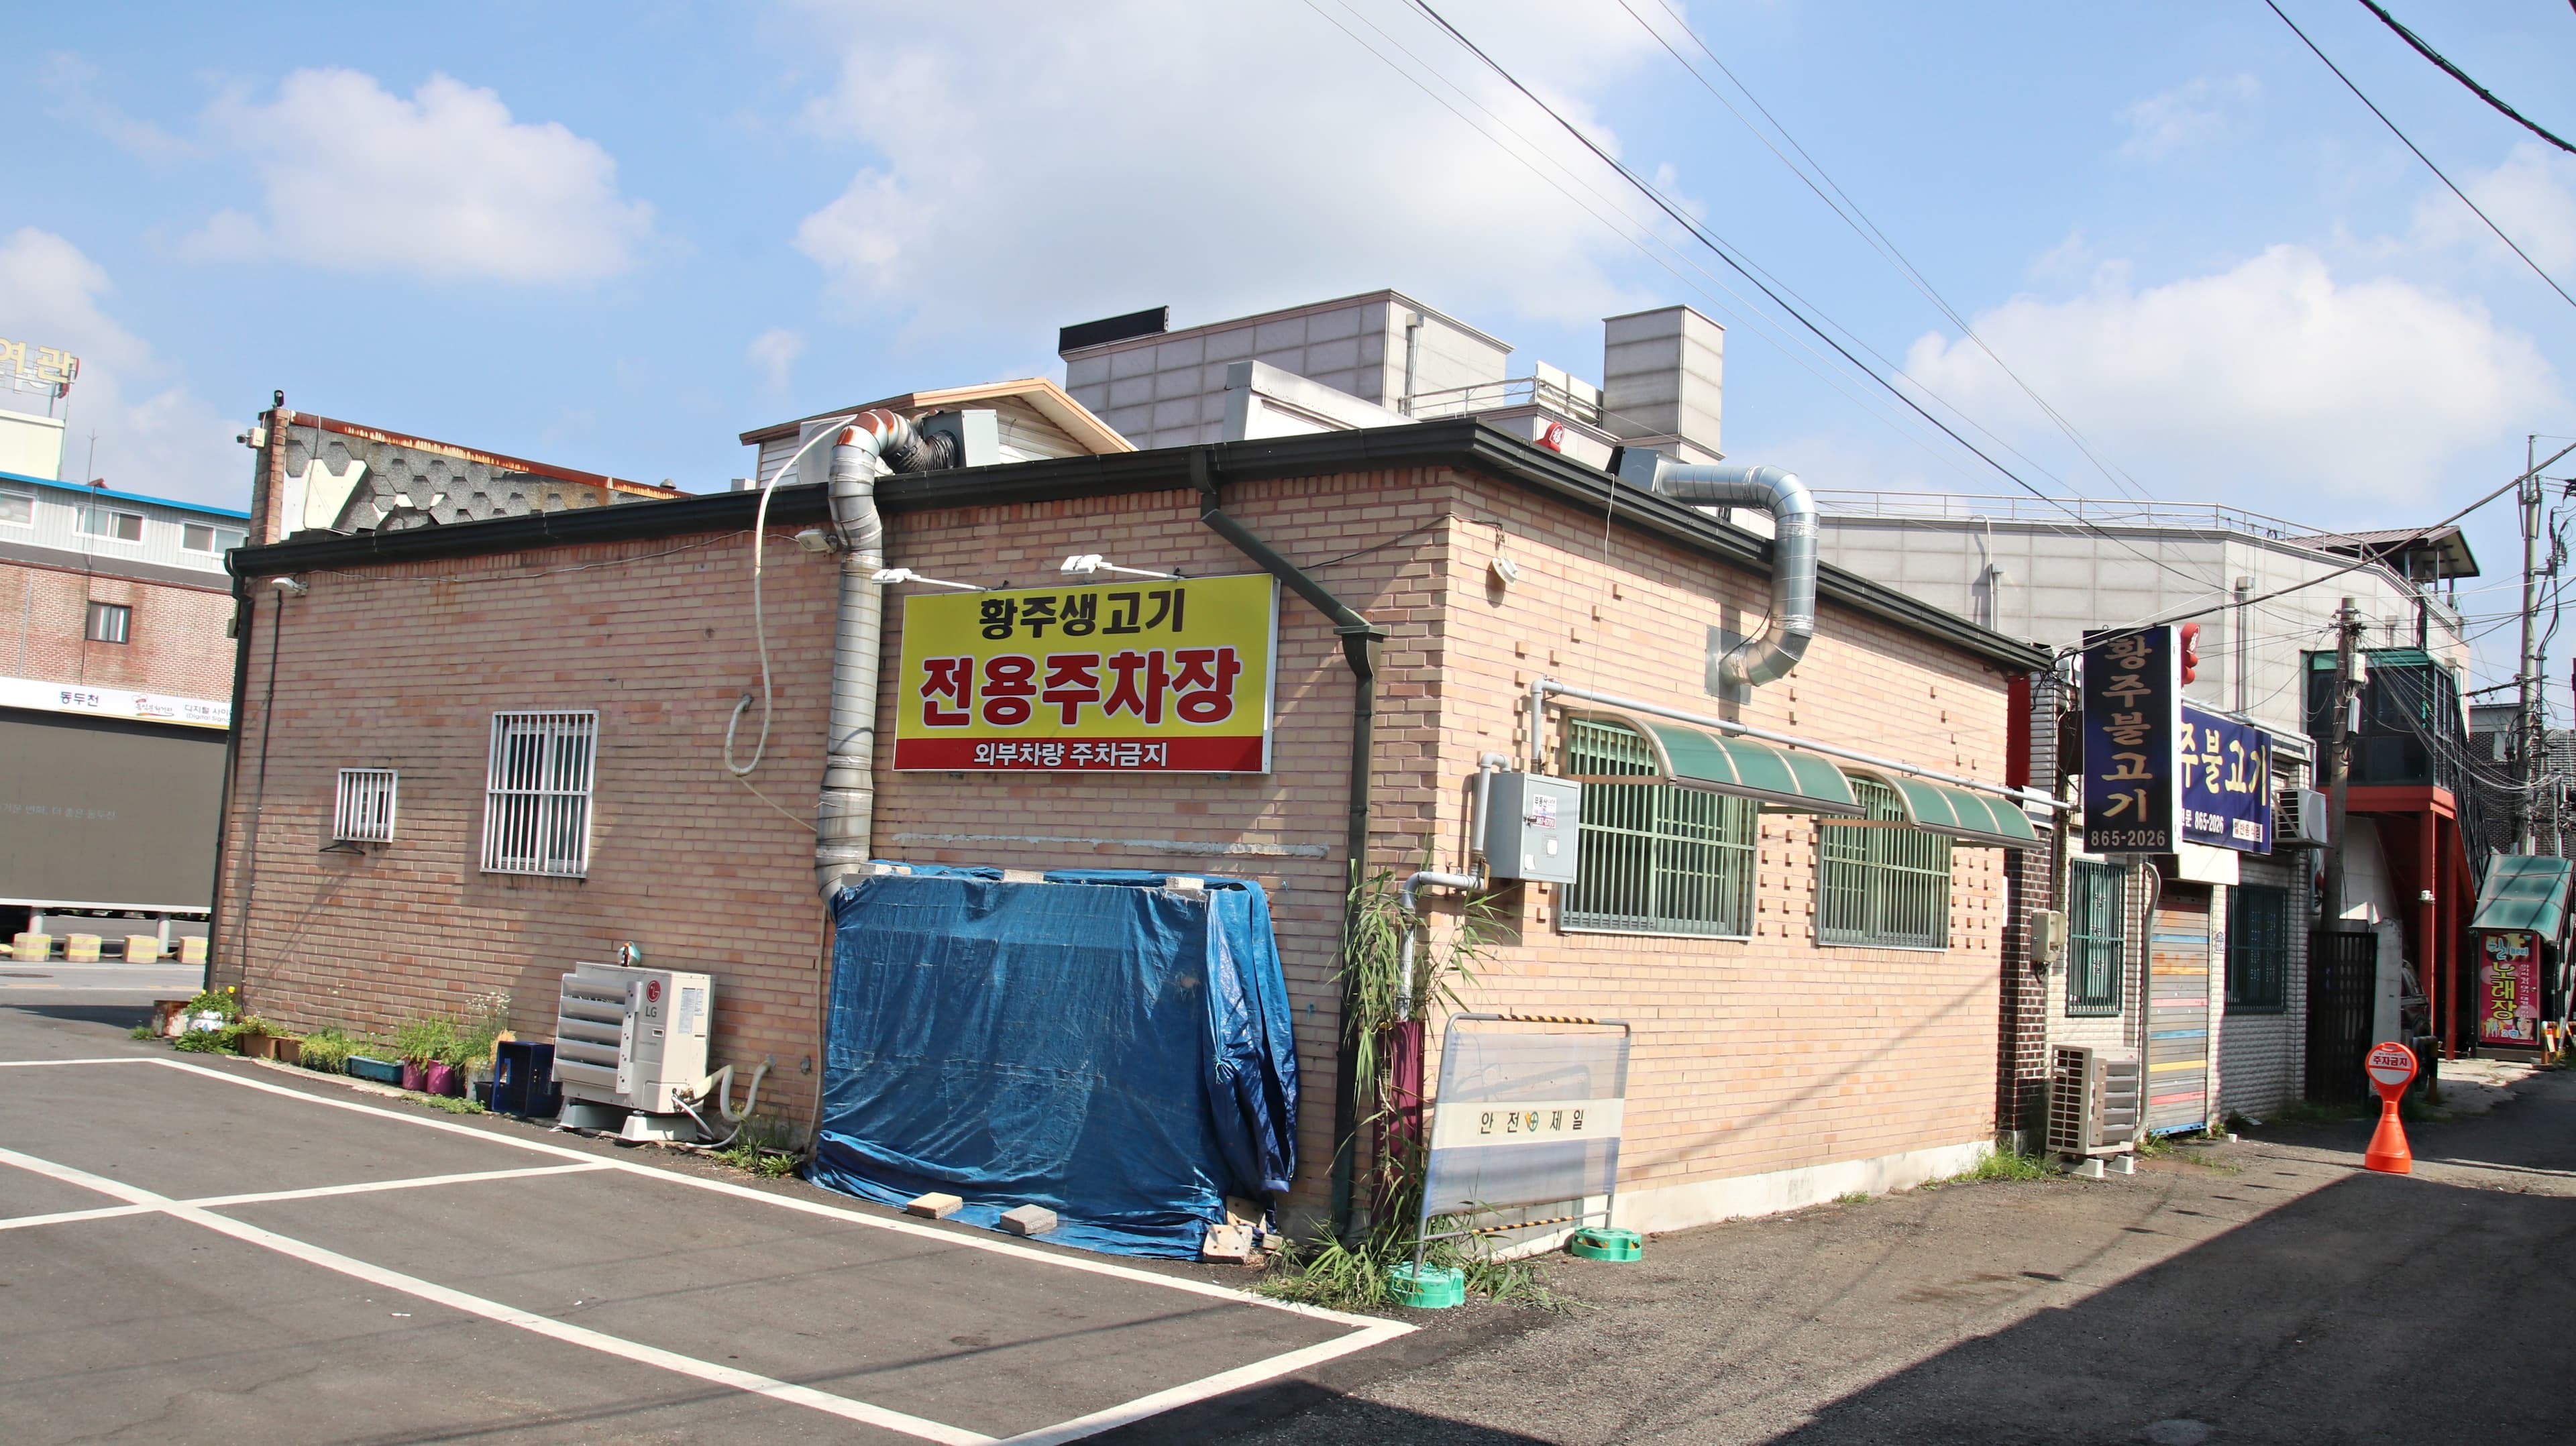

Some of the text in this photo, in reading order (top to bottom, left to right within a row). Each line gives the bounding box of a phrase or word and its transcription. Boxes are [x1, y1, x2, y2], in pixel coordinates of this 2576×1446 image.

[0, 337, 76, 384] 여관
[978, 588, 1185, 641] 황주생고기
[60, 691, 99, 707] 동두천
[920, 647, 1242, 727] 전용주차장
[184, 704, 232, 717] 디지털 사이
[2101, 634, 2153, 822] 황주불고기
[973, 741, 1167, 767] 외부차량 주차금지
[2194, 810, 2224, 834] 865-2026
[2090, 830, 2166, 847] 865-2026
[2490, 961, 2518, 1020] 노래장
[645, 1007, 657, 1018] LG
[1480, 1109, 1584, 1135] 안전 제일
